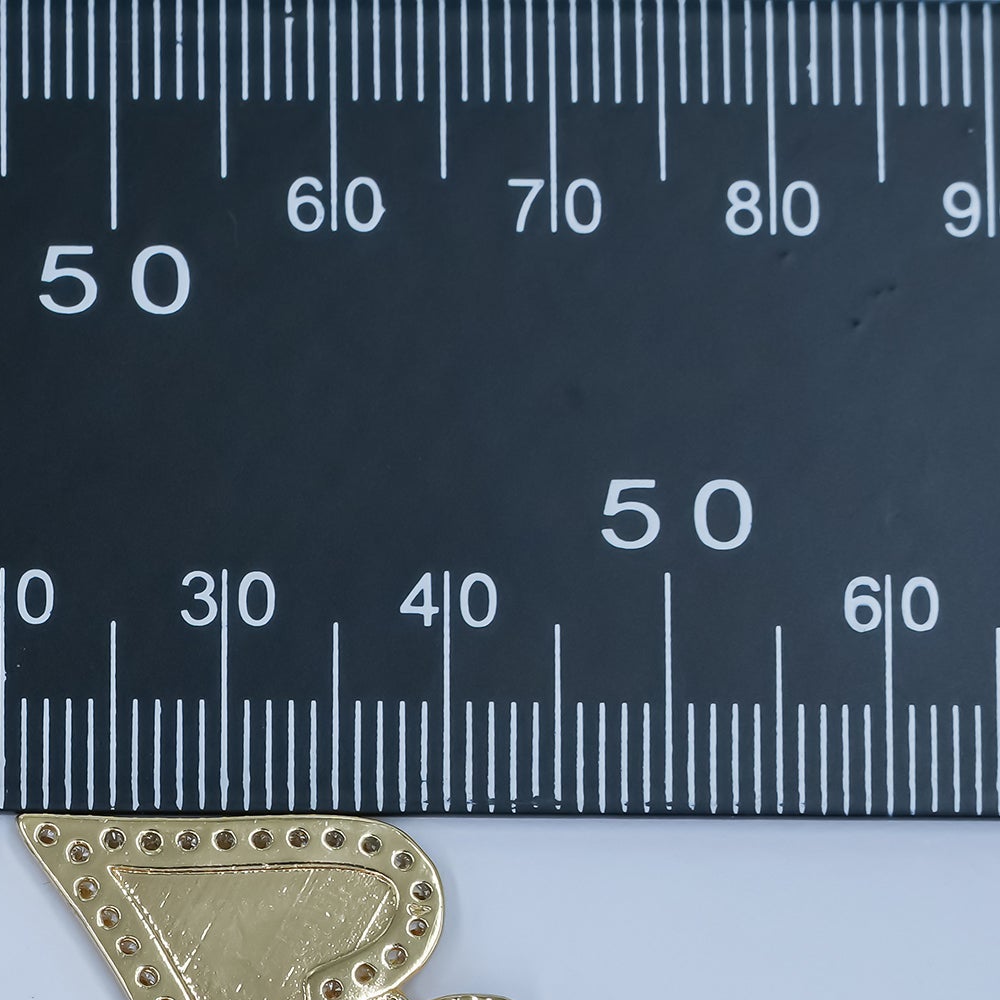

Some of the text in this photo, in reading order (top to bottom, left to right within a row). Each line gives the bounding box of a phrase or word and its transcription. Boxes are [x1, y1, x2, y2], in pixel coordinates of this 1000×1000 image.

[288, 177, 382, 232] 60
[508, 178, 601, 234] 70
[726, 180, 819, 236] 80
[943, 182, 1000, 238] 9
[39, 245, 190, 315] 50
[602, 479, 752, 550] 50
[181, 570, 275, 627] 30
[400, 572, 497, 628] 40
[844, 576, 939, 632] 60
